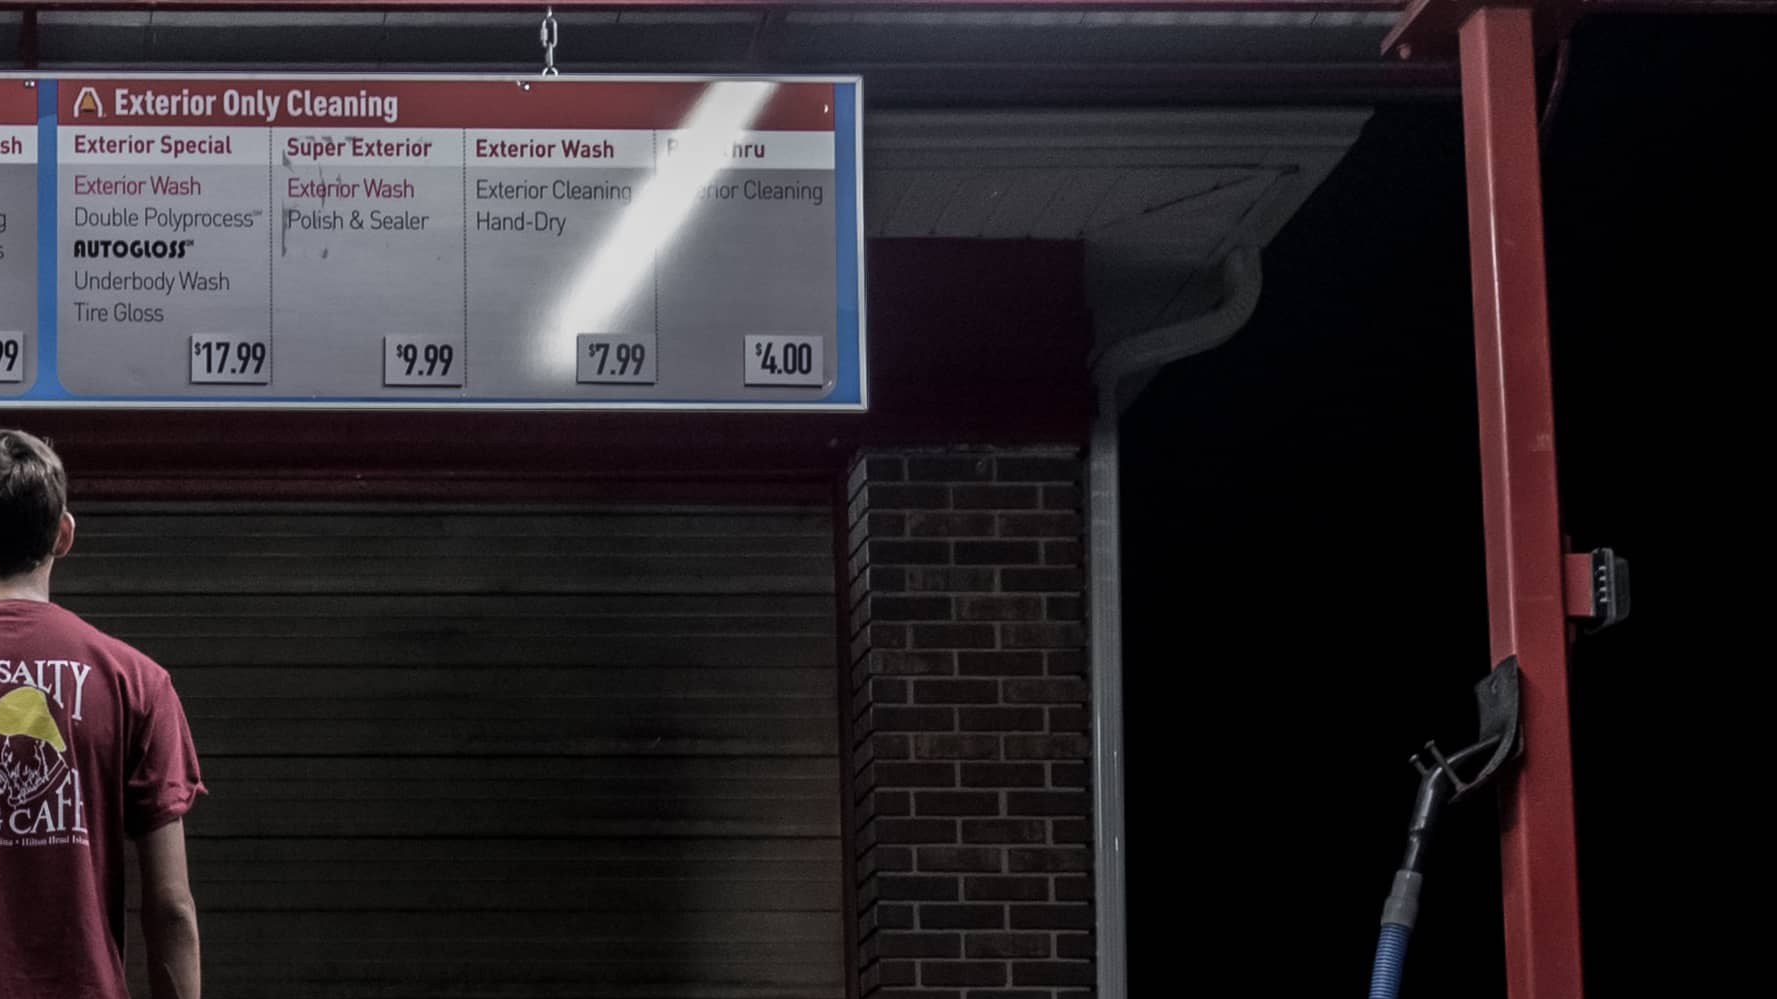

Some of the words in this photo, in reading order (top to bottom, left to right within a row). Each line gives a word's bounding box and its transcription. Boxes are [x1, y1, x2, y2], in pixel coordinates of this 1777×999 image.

[114, 89, 216, 116] Exterior
[223, 90, 281, 122] Only
[286, 90, 399, 123] Cleaning
[74, 135, 155, 154] Exterior
[160, 135, 233, 158] Special
[286, 138, 346, 160] Super
[351, 138, 433, 157] Exterior
[476, 139, 556, 158] Exterior
[561, 139, 615, 158] Wash
[724, 140, 765, 157] hru
[74, 175, 148, 196] Exterior
[149, 176, 202, 195] Wash
[287, 178, 360, 199] Exterior
[363, 179, 415, 199] Wash
[476, 180, 548, 200] Exterior
[552, 180, 632, 205] Cleaning
[744, 181, 824, 206] Cleaning
[74, 207, 139, 228] Double
[287, 210, 344, 231] Polish
[349, 210, 364, 230] &
[369, 210, 430, 231] Sealer
[476, 211, 567, 237] Hand-Dry
[74, 271, 175, 296] Underbody
[178, 272, 230, 292] Wash
[74, 302, 109, 322] Tire
[113, 302, 164, 323] Gloss
[194, 341, 266, 375] $17.99
[396, 344, 454, 376] $9.99
[588, 343, 645, 375] $7.99
[755, 343, 812, 375] $4.00
